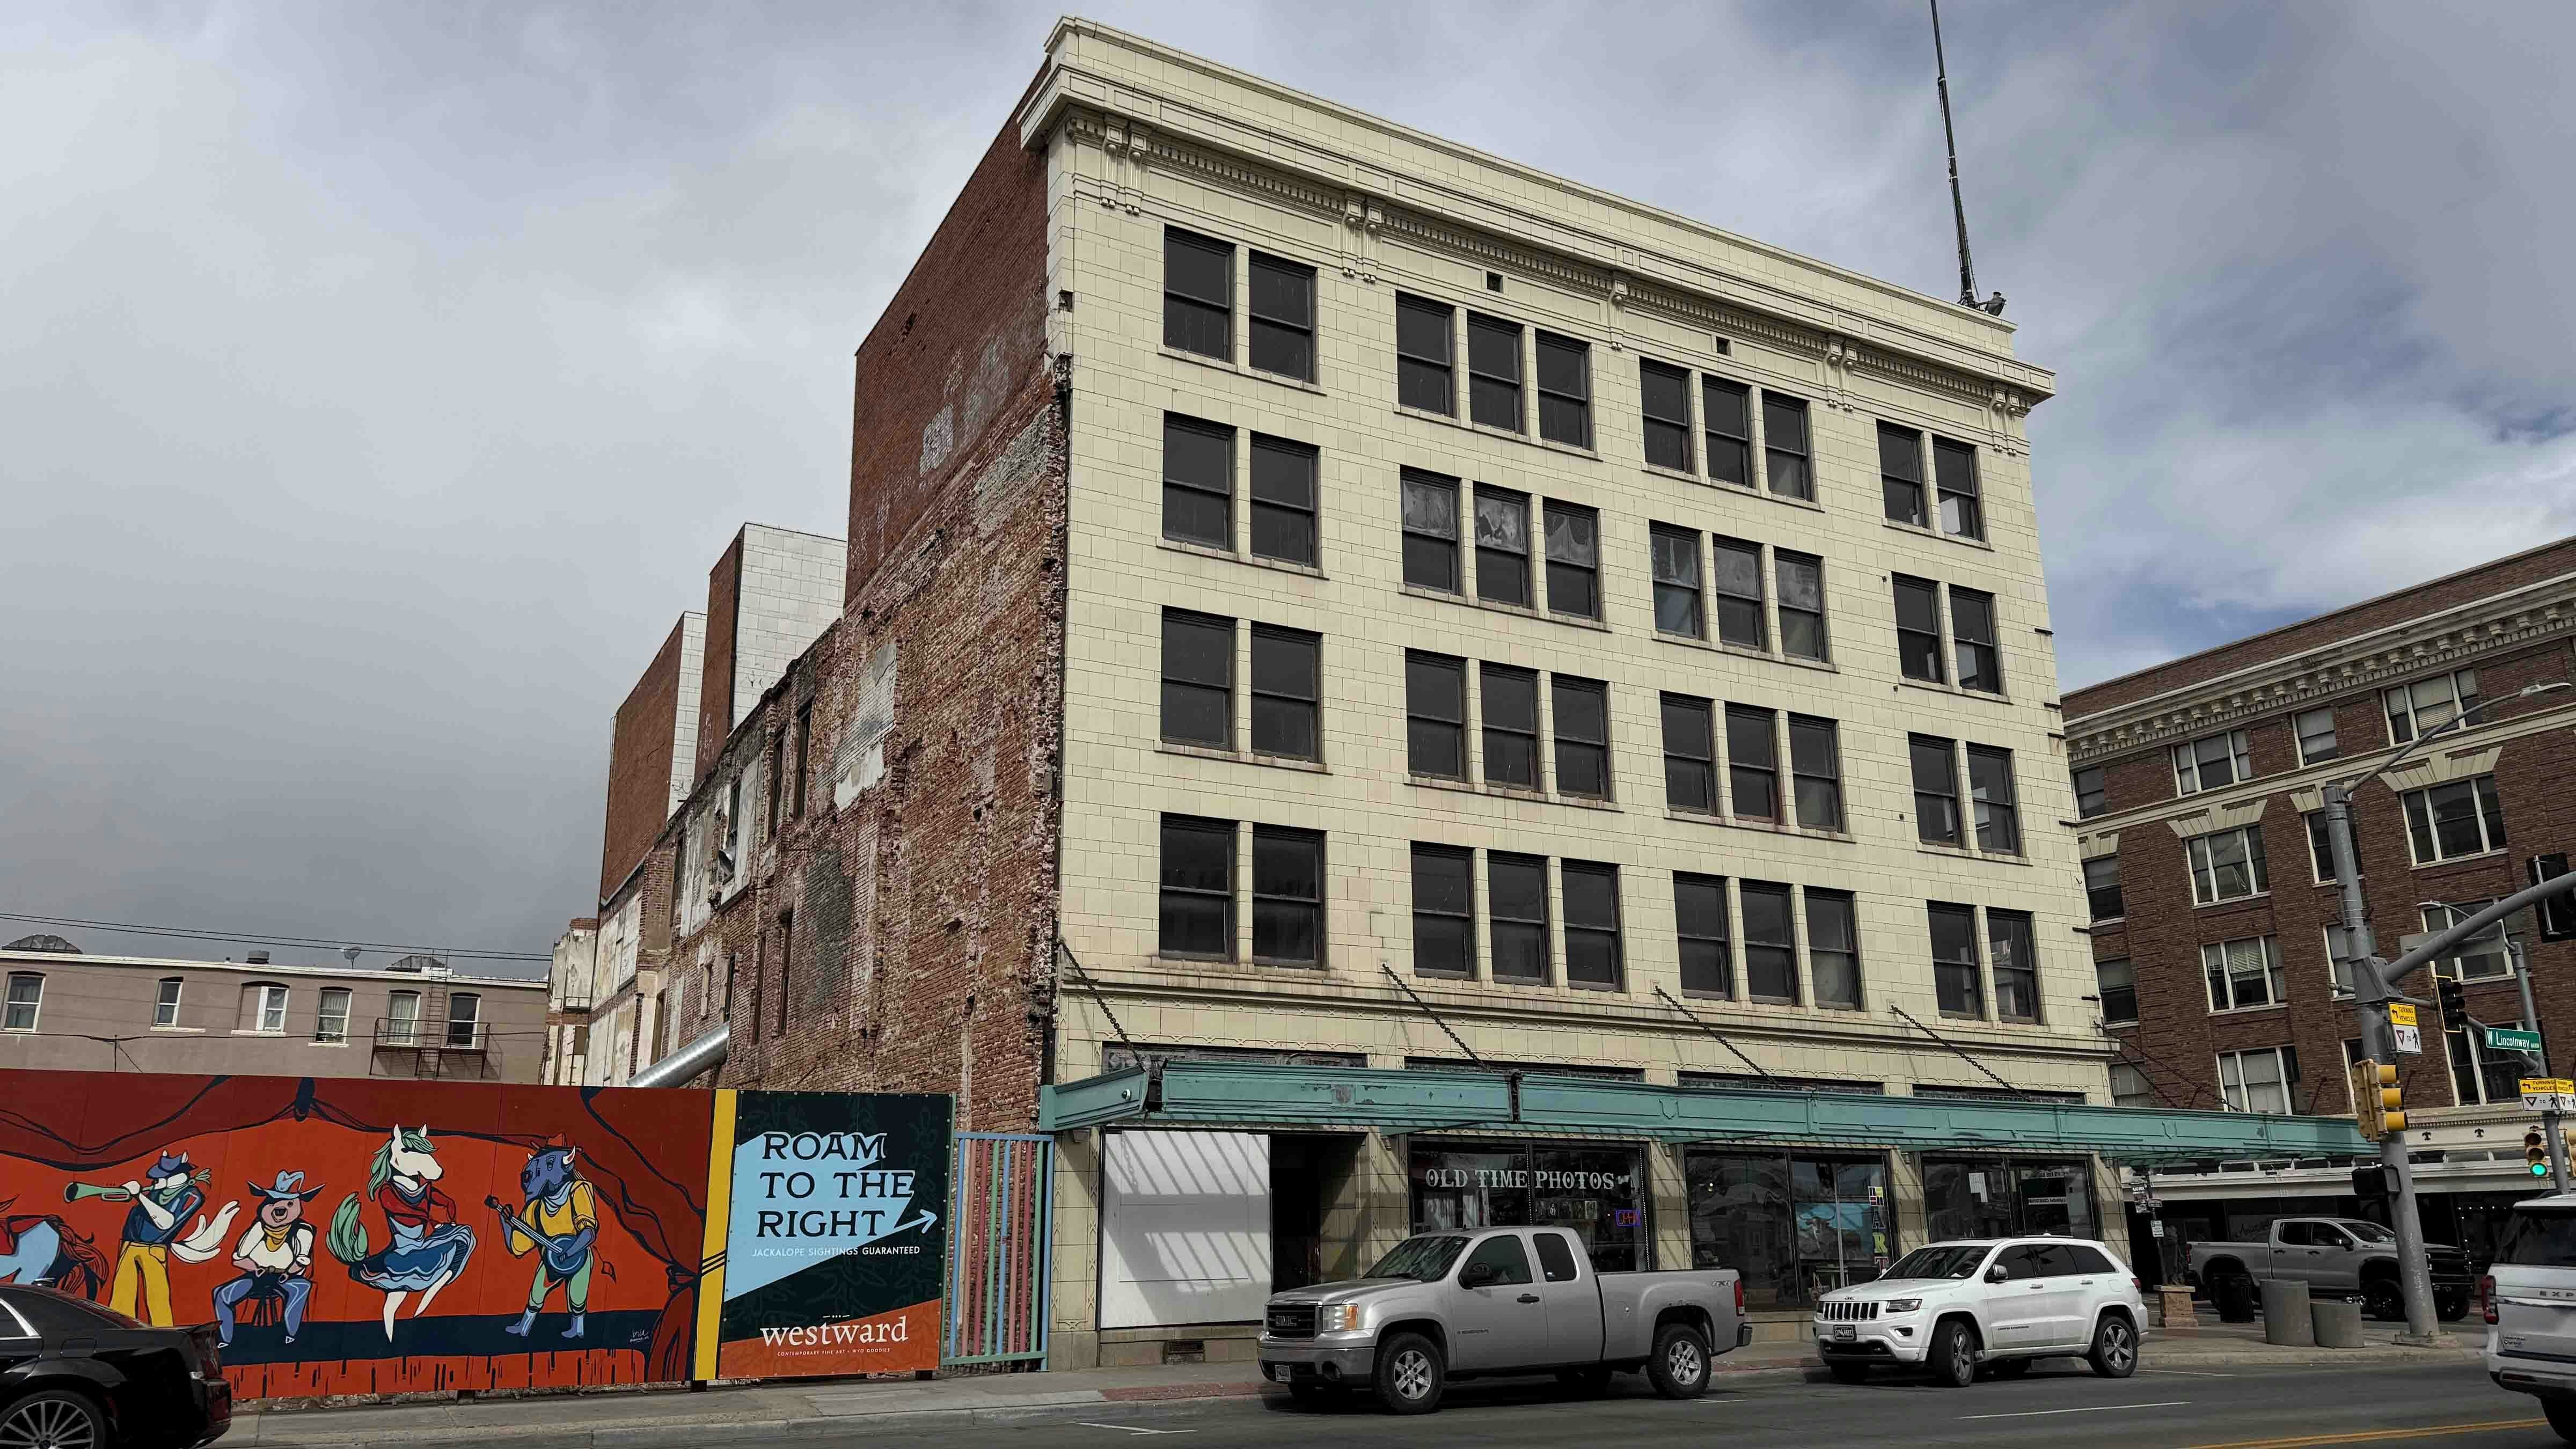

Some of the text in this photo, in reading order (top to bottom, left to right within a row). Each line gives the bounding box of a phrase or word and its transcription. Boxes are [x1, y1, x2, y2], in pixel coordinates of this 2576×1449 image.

[2487, 1030, 2529, 1050] W Lincolnway
[762, 1132, 887, 1160] ROAM
[759, 1171, 914, 1198] TO THE
[1425, 1168, 1614, 1189] OLD TIME PHOTOS
[756, 1210, 886, 1237] RIGHT
[751, 1246, 920, 1257] JACKALOPE SIGHTINGS GUARANTEED
[759, 1315, 909, 1348] westward
